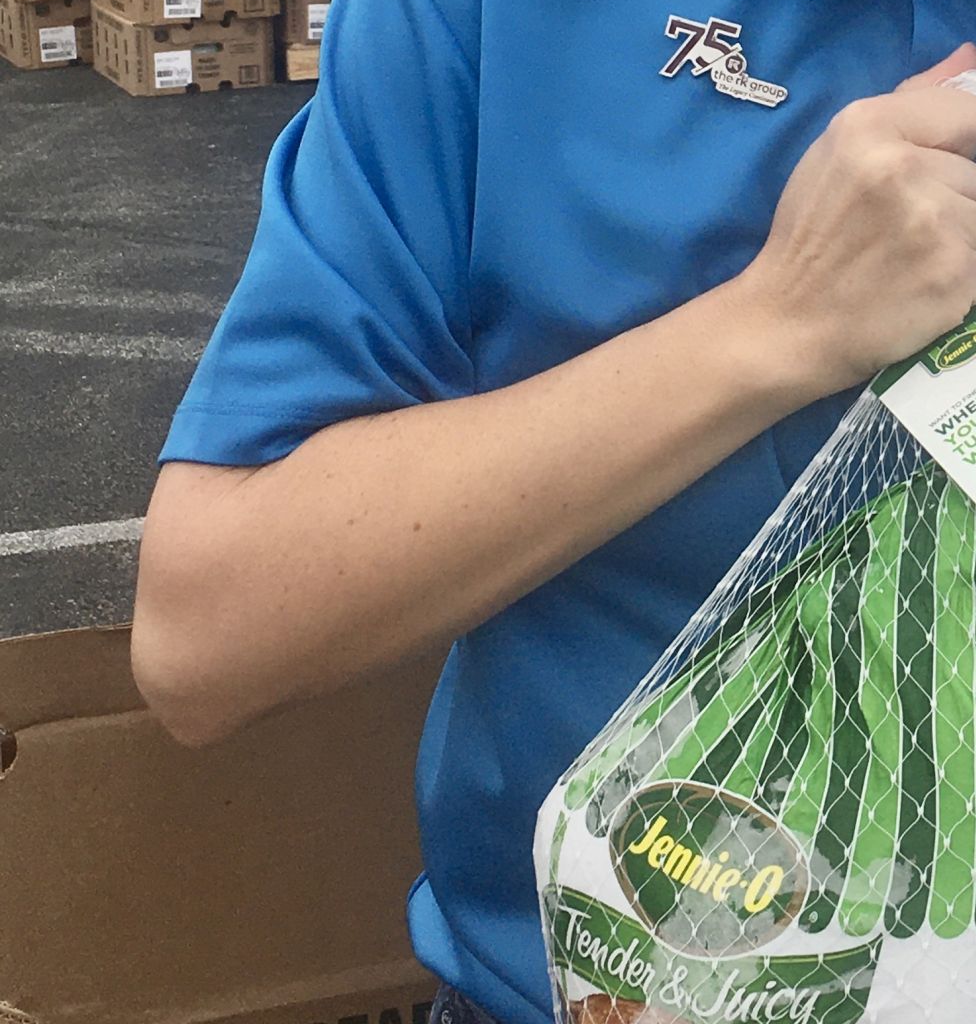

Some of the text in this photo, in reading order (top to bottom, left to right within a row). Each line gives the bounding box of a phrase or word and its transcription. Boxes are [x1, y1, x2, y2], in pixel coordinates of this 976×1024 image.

[667, 19, 738, 74] 75
[714, 70, 734, 83] the
[735, 74, 748, 88] rk
[750, 81, 785, 99] group
[557, 905, 822, 1024] Tender & Juicy
